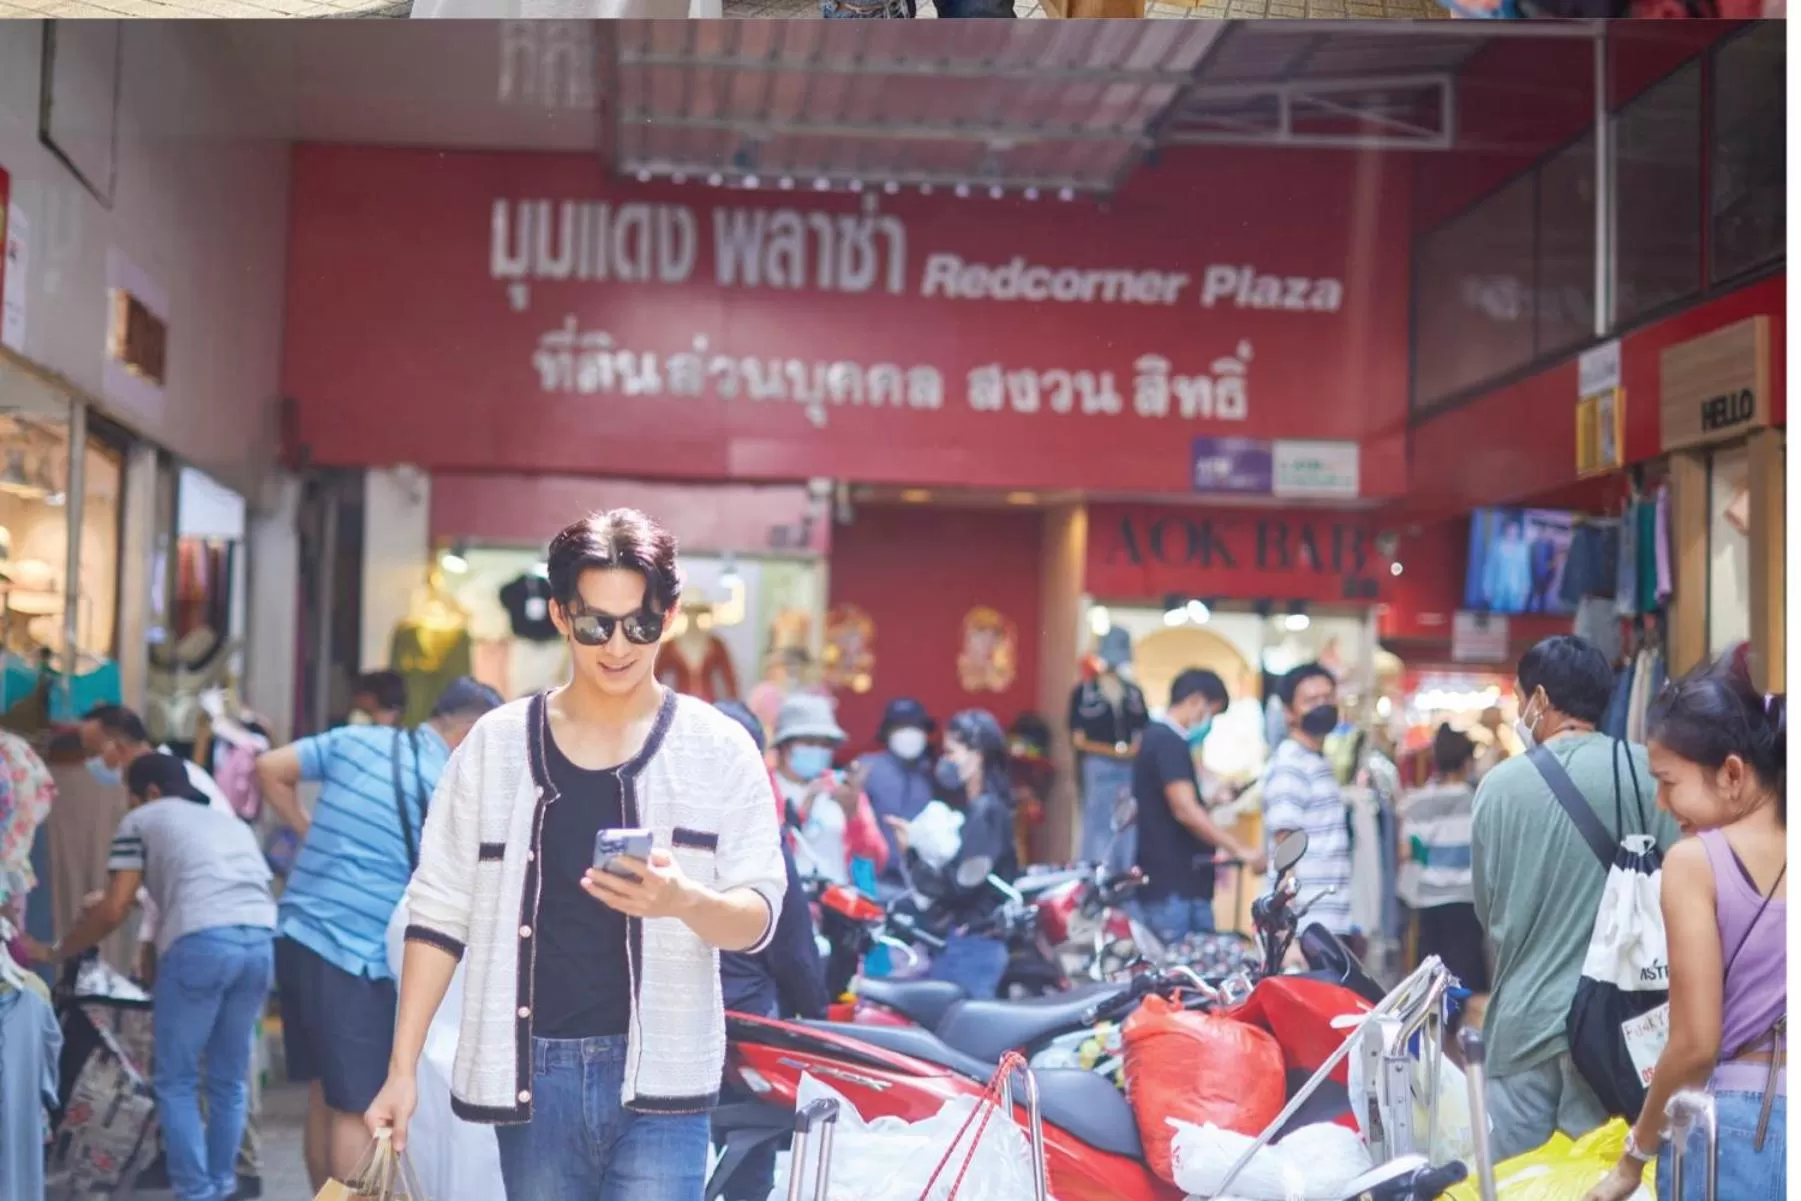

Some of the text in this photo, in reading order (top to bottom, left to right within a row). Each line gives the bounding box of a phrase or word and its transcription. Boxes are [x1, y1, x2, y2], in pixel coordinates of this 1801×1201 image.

[490, 198, 698, 312] มุมแดง
[921, 252, 1343, 312] Redcorner Plaza
[1701, 388, 1755, 433] HELLO
